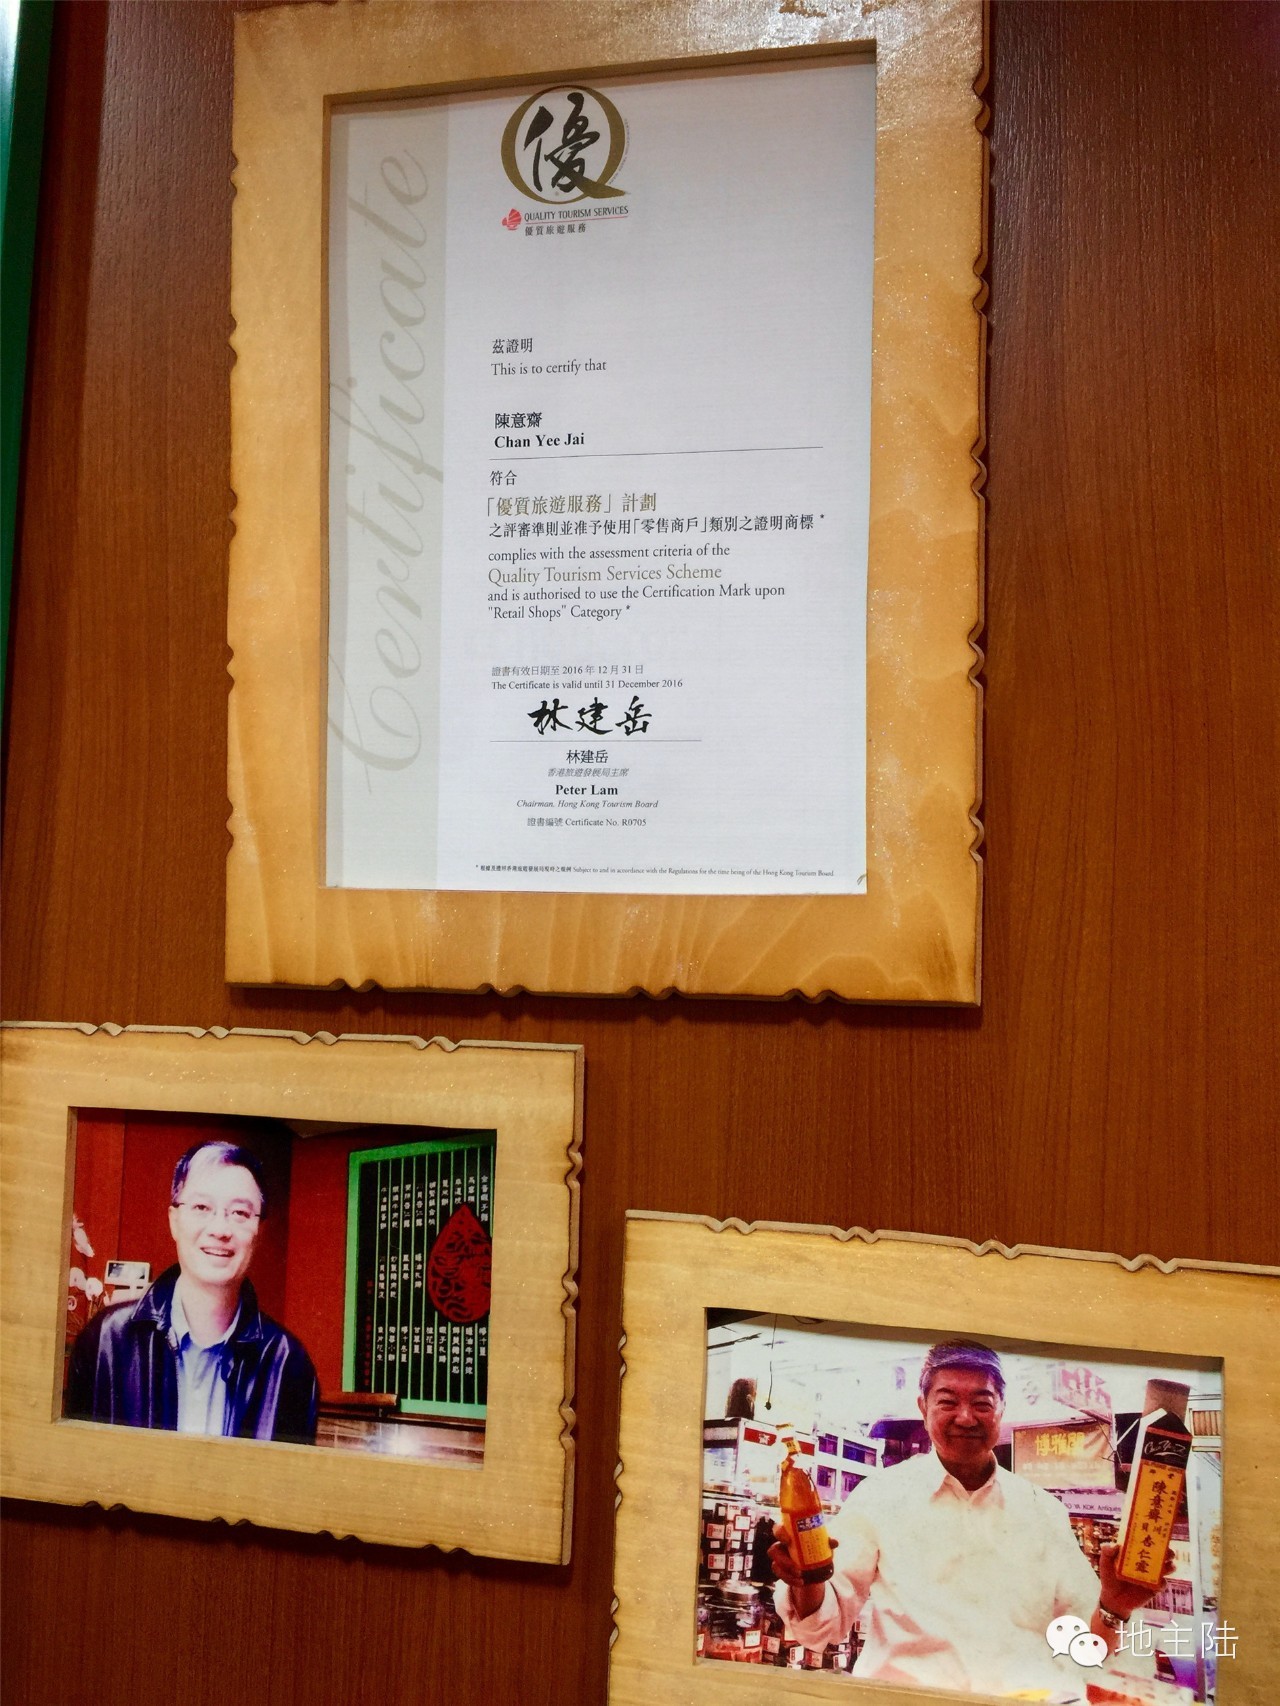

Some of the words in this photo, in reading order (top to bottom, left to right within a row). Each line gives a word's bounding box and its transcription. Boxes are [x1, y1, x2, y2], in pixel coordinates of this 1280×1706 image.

[524, 211, 555, 222] QUALITY
[558, 209, 591, 219] TOURISM
[594, 206, 628, 216] SERVICES
[525, 223, 586, 236] 優質旅遊服務
[491, 363, 516, 375] This
[520, 363, 528, 374] is
[532, 366, 542, 374] to
[546, 359, 581, 375] certify
[585, 358, 606, 371] that
[494, 436, 530, 448] Chan
[536, 435, 560, 446] Yee
[564, 433, 584, 445] Jai
[489, 470, 517, 486] 符合
[488, 546, 536, 564] complies
[540, 546, 564, 560] with
[568, 546, 586, 560] the
[589, 546, 649, 559] assessment
[653, 544, 692, 557] criteria
[696, 543, 710, 556] of
[712, 544, 730, 556] the
[488, 568, 540, 588] Quality
[544, 567, 601, 582] Tourism
[607, 565, 661, 582] Services
[667, 564, 722, 579] Scheme
[488, 588, 508, 602] and
[512, 589, 520, 601] is
[523, 588, 581, 601] authorised
[585, 589, 596, 600] to
[600, 590, 618, 600] use
[621, 586, 639, 599] the
[642, 585, 715, 599] Certification
[719, 584, 750, 597] Mark
[754, 586, 785, 600] upon
[570, 605, 622, 621] Category
[586, 665, 595, 674] 年
[611, 665, 619, 674] 月
[622, 665, 631, 673] 31
[636, 665, 643, 673] 日
[566, 750, 608, 764] 林建岳
[555, 784, 587, 795] Peter
[591, 784, 618, 795] Lam
[558, 800, 578, 809] Hong
[579, 800, 600, 809] Kong
[565, 818, 604, 827] Certificate
[606, 819, 619, 827] No.
[622, 818, 647, 827] R0705
